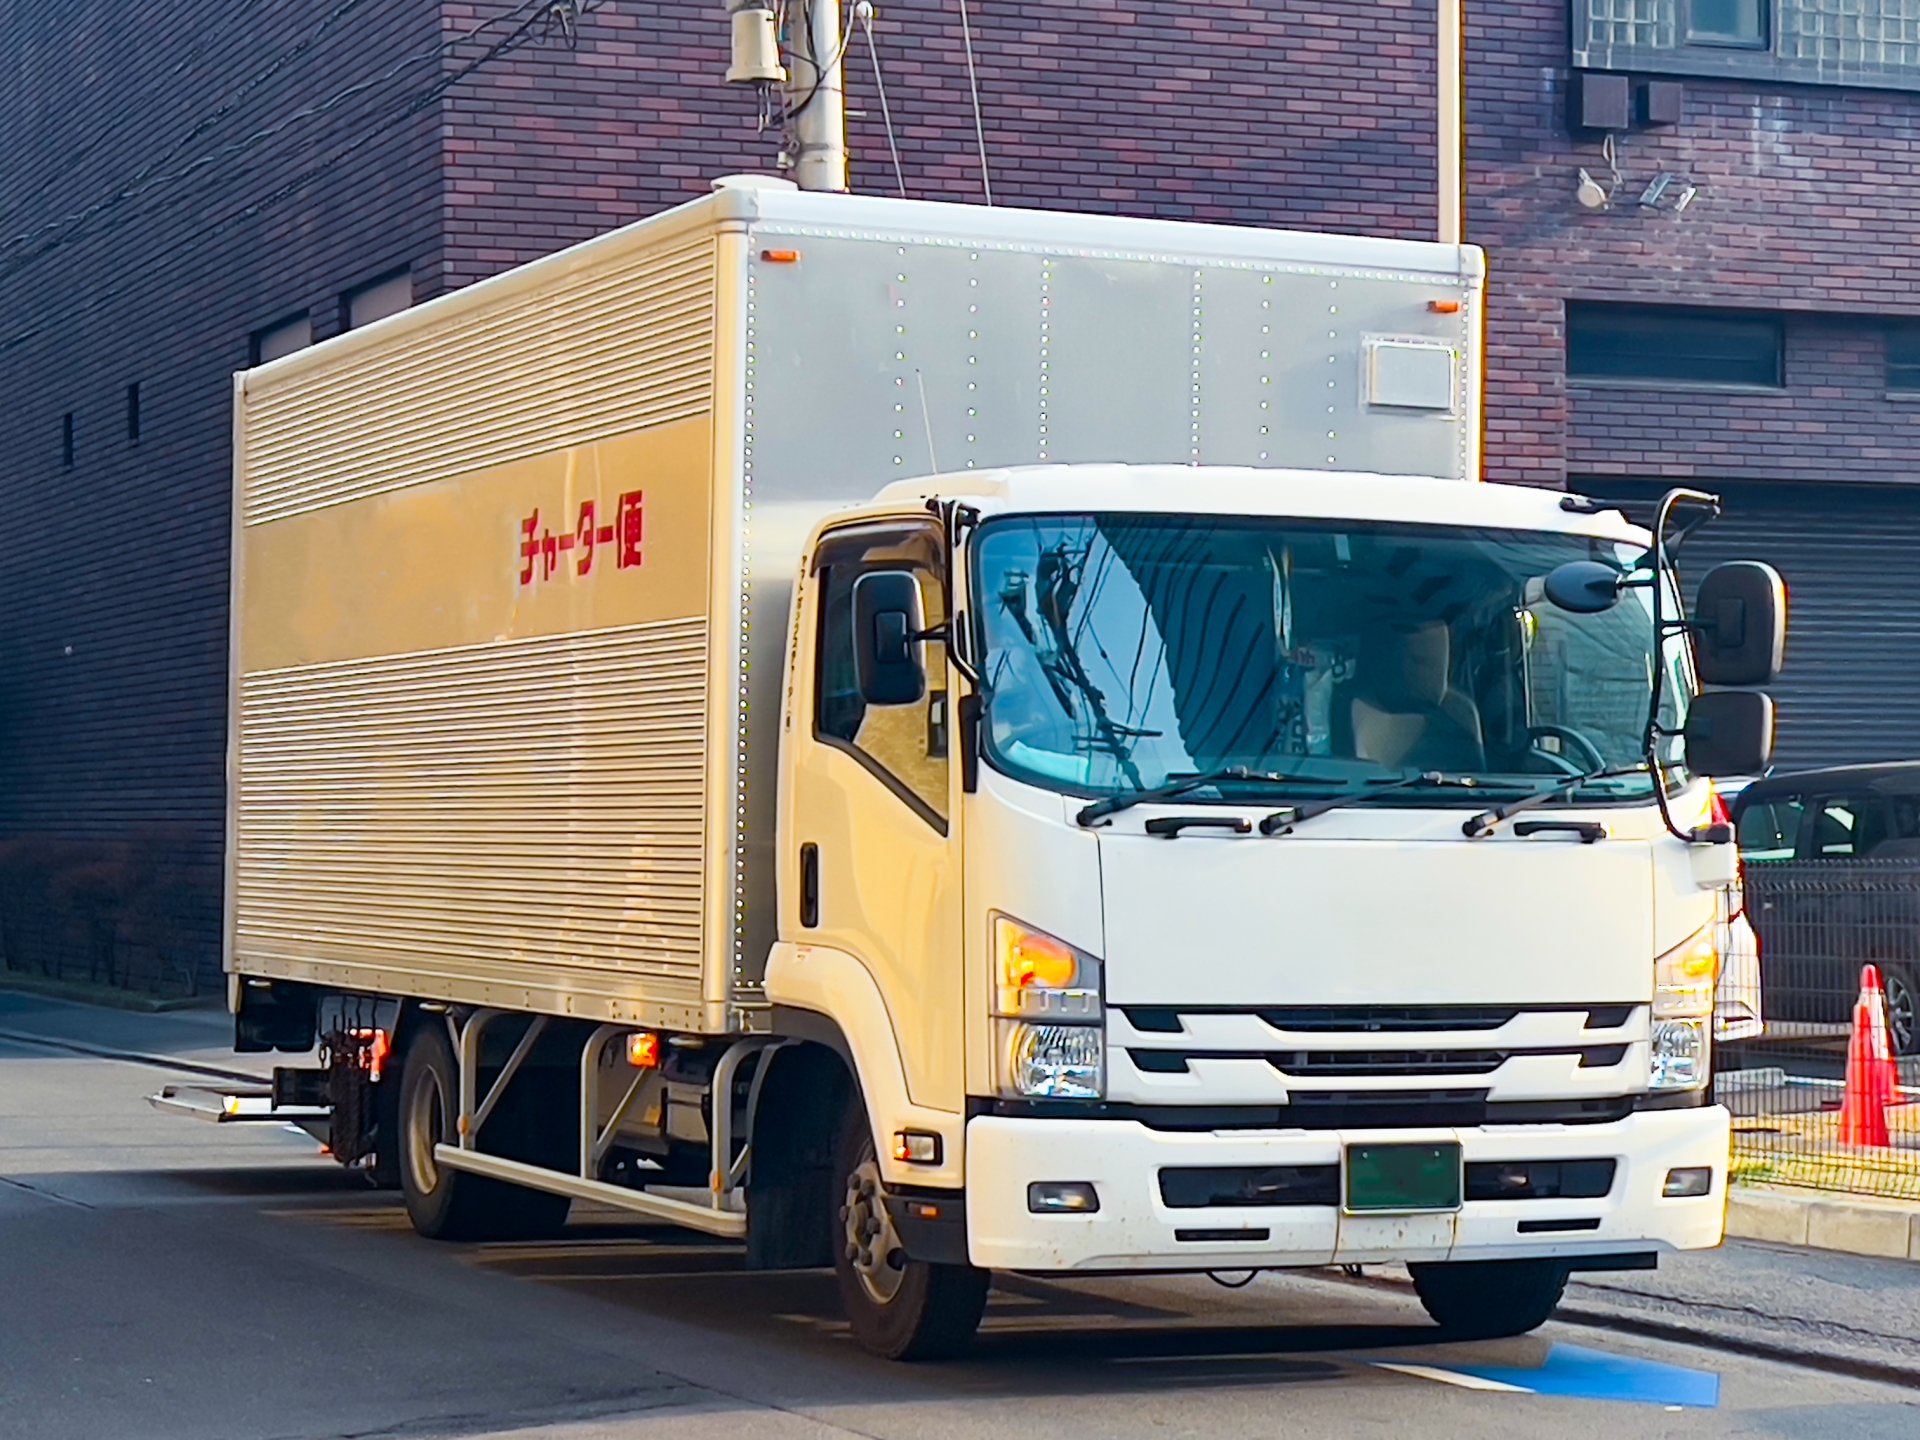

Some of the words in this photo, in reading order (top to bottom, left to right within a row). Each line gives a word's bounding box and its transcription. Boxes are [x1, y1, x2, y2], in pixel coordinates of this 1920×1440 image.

[520, 489, 643, 586] チャーター便
